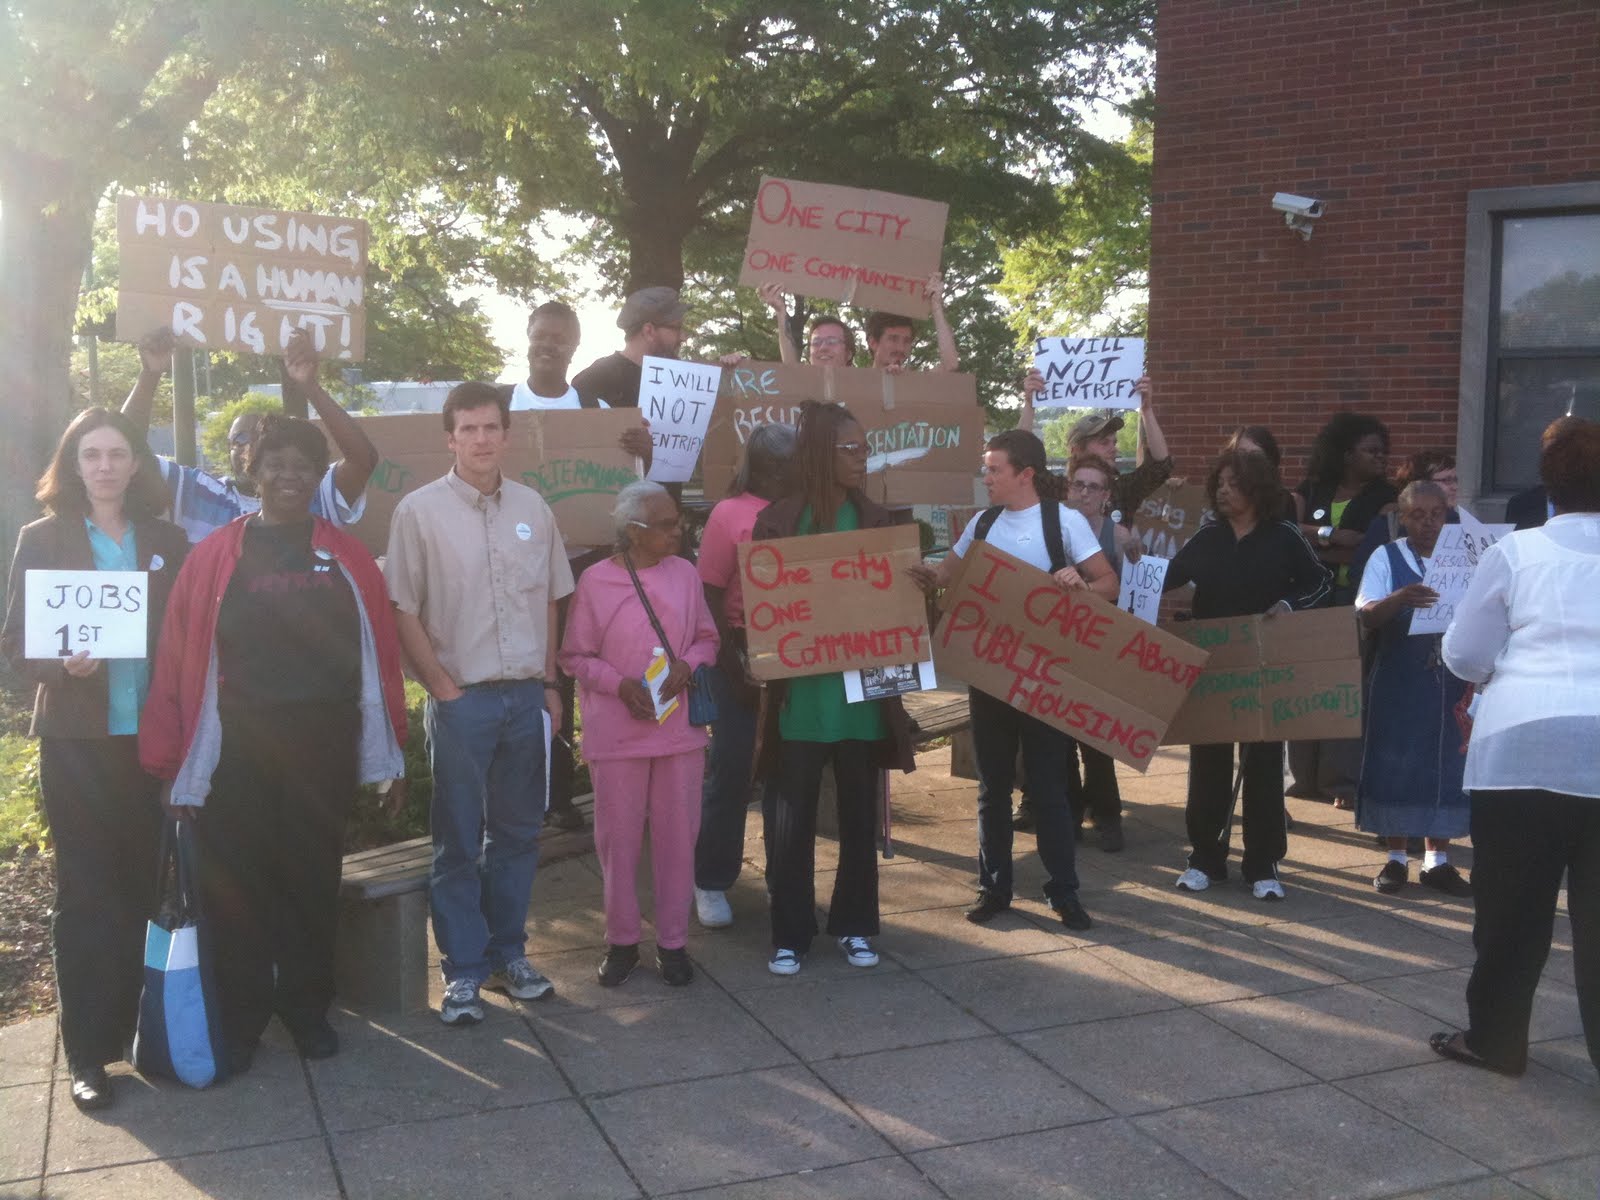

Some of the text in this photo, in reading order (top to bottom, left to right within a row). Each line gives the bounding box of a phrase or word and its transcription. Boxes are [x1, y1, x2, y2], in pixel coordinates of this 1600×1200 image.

[758, 180, 911, 241] ONE CITY
[749, 249, 798, 273] ONE
[169, 255, 364, 307] IS A HUMAN
[1035, 337, 1125, 356] I WILL
[648, 366, 717, 393] I WILL
[1046, 357, 1121, 385] NOT
[650, 396, 707, 425] NOT
[745, 545, 812, 590] One
[46, 583, 142, 614] JOBS
[751, 600, 813, 632] ONE
[968, 552, 1017, 603] I
[1023, 586, 1115, 650] CARE
[1117, 630, 1207, 690] ABOUT
[54, 624, 103, 657] 1ST
[943, 600, 1071, 687] PUBLIC
[1006, 672, 1159, 760] HOUSING
